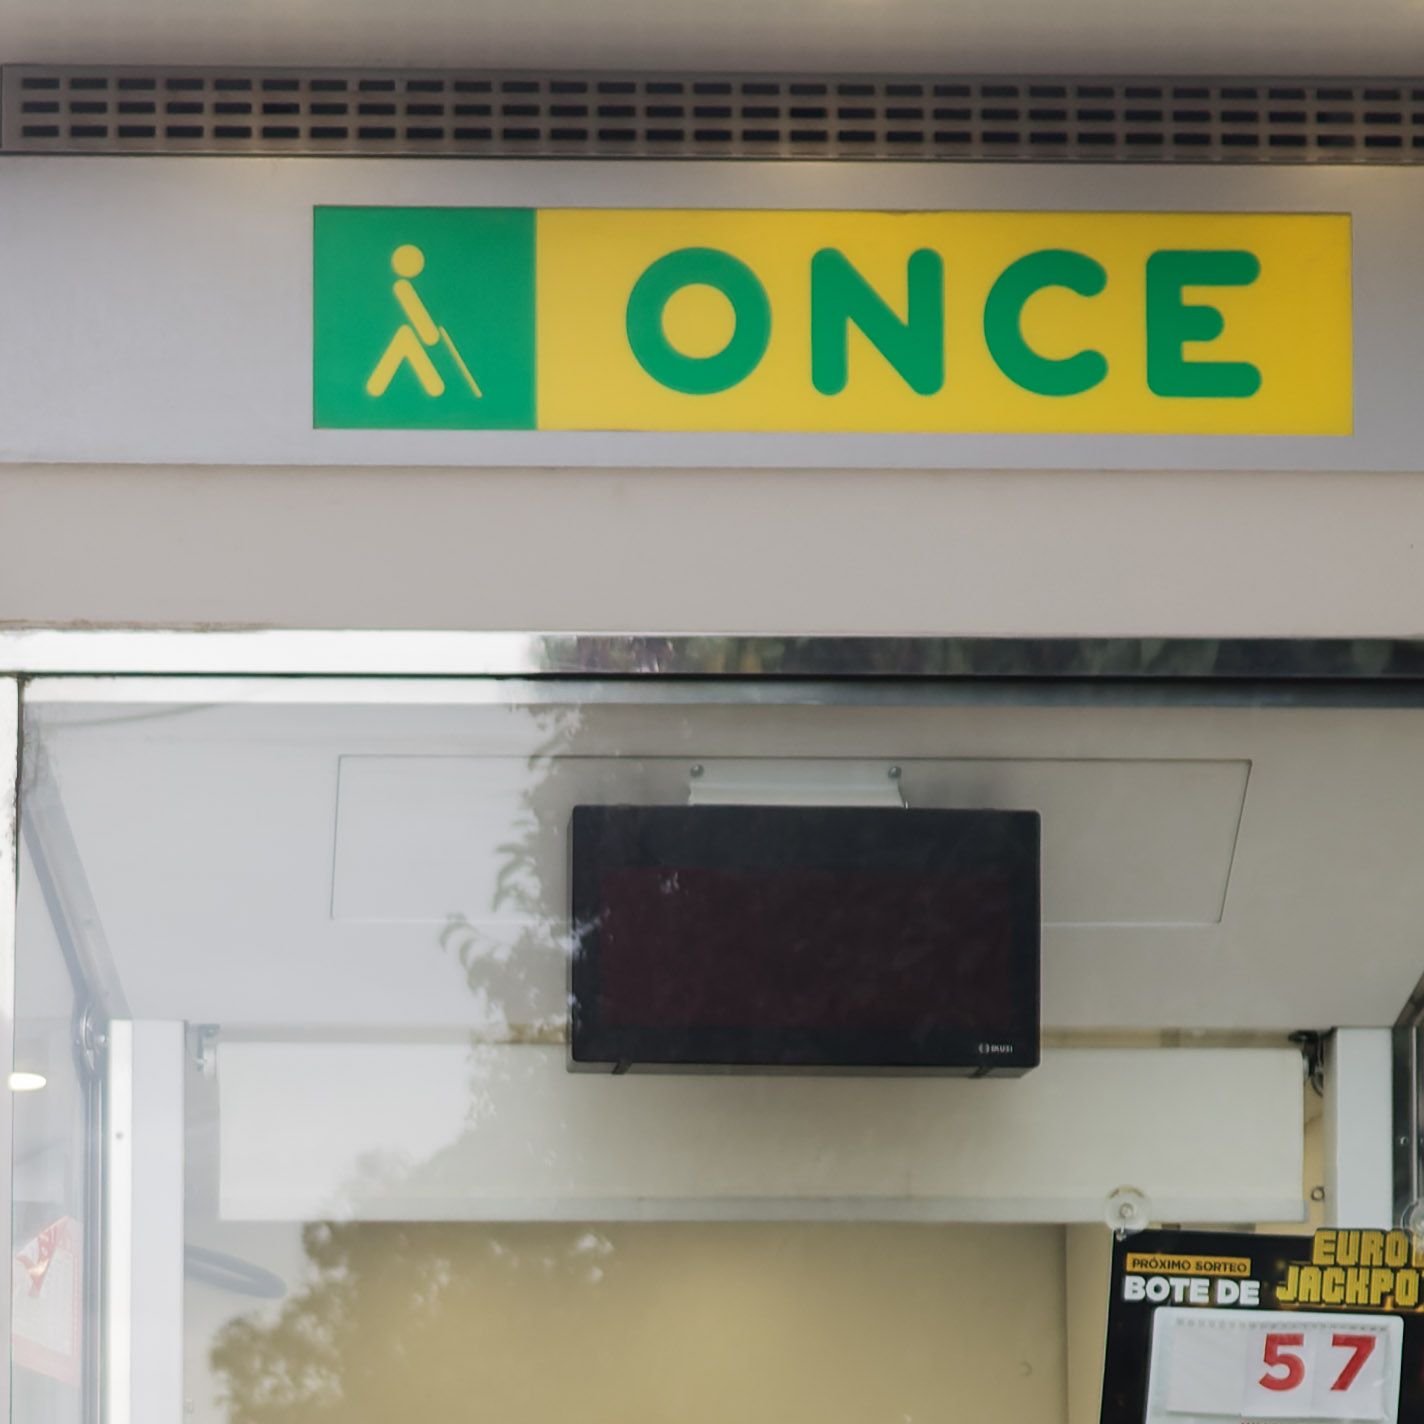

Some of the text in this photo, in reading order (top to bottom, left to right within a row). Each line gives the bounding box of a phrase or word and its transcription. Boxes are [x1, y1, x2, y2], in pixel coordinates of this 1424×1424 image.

[625, 246, 1262, 397] ONCE
[1313, 1229, 1408, 1267] EURO
[1132, 1258, 1247, 1273] PRÓXIMO SORTEO
[1124, 1275, 1260, 1305] BOTE DE
